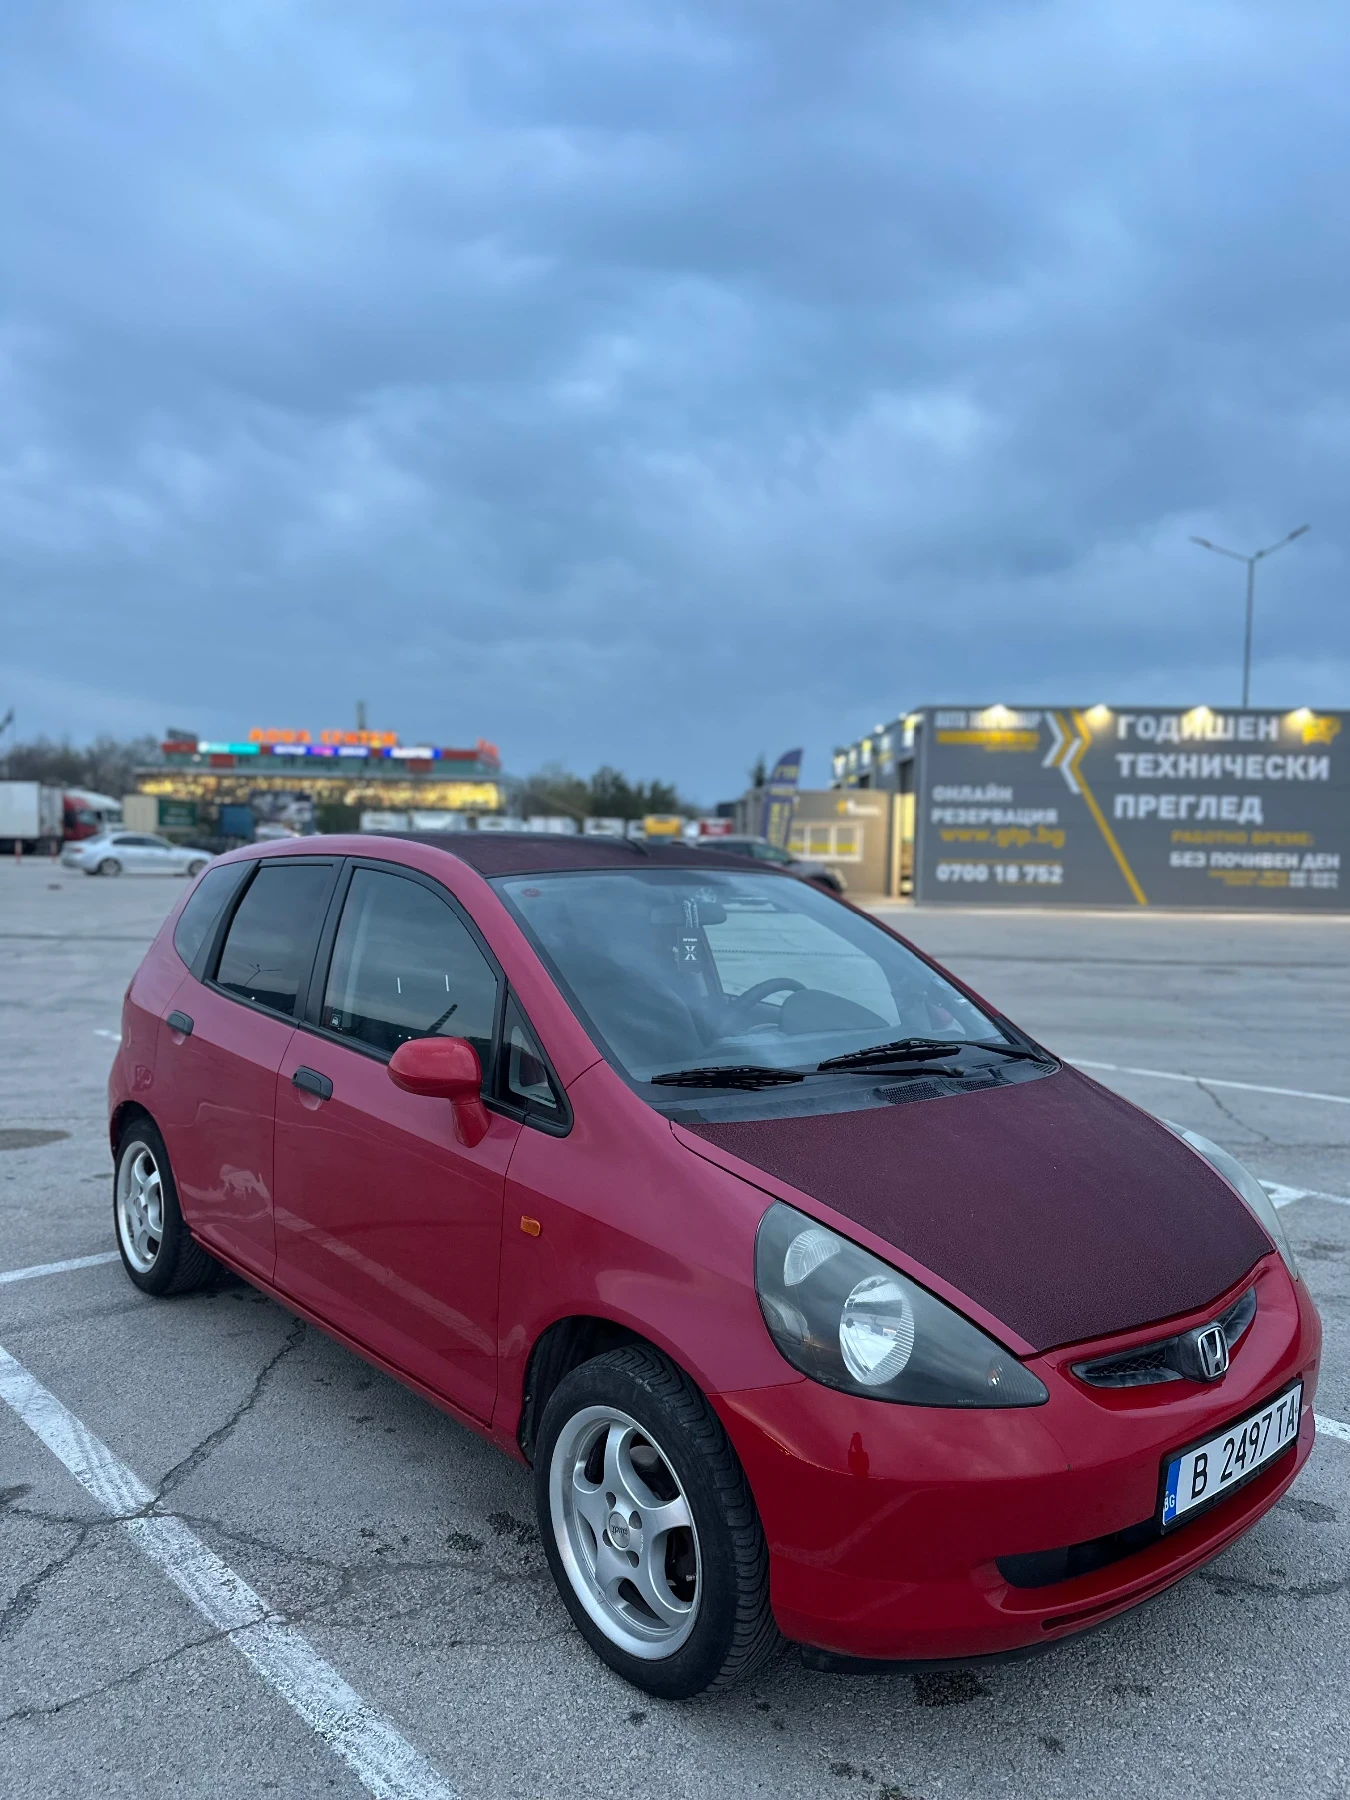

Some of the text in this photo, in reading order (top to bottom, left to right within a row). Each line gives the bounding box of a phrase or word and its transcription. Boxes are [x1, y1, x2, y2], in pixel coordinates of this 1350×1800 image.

[1117, 714, 1279, 743] ГОДИШЕН
[1115, 752, 1330, 780] ТЕХНИЧЕСКИ
[932, 783, 1013, 802] ОНЛАЙН
[931, 807, 1058, 827] РЕЗЕРВАЦИЯ
[1114, 793, 1263, 824] ПРЕГЛЕД
[940, 825, 1065, 848] www.gtp.bg
[1169, 851, 1340, 869] БЕЗ ПОЧИВЕН ДЕН
[936, 863, 1064, 884] 0700 18 752
[1191, 1452, 1208, 1500] B
